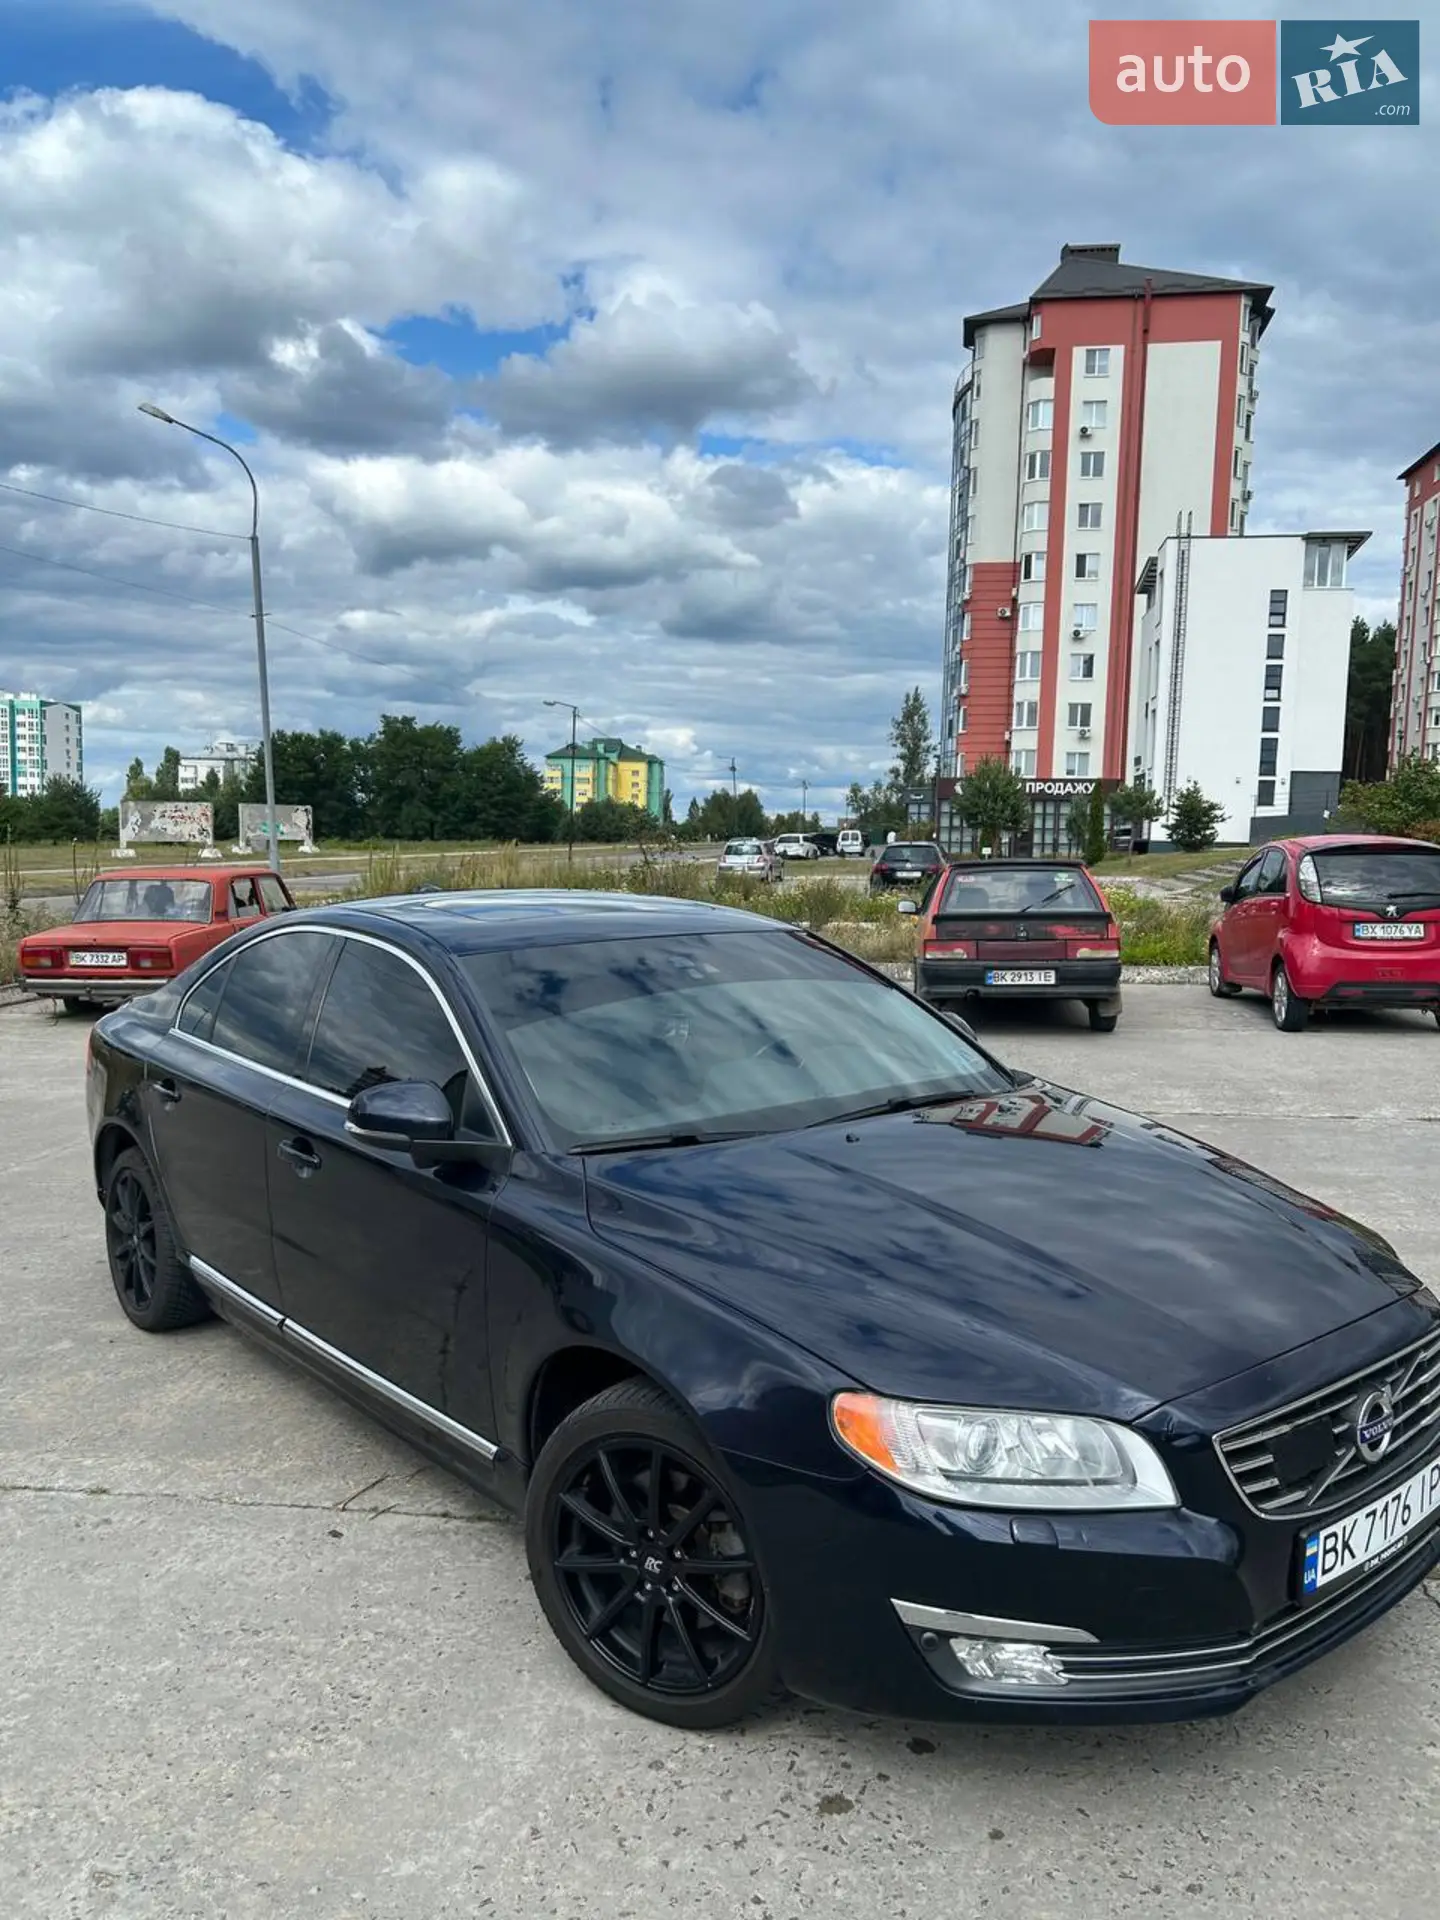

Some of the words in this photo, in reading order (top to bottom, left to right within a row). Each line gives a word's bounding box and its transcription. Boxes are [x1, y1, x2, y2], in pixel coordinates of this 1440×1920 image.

[1025, 782, 1096, 796] ПРОДАЖУ
[1380, 924, 1405, 936] 1076
[1010, 971, 1035, 983] 2913
[1321, 1517, 1359, 1578] BK
[1364, 1484, 1413, 1553] 7176
[1304, 1568, 1317, 1585] UA
